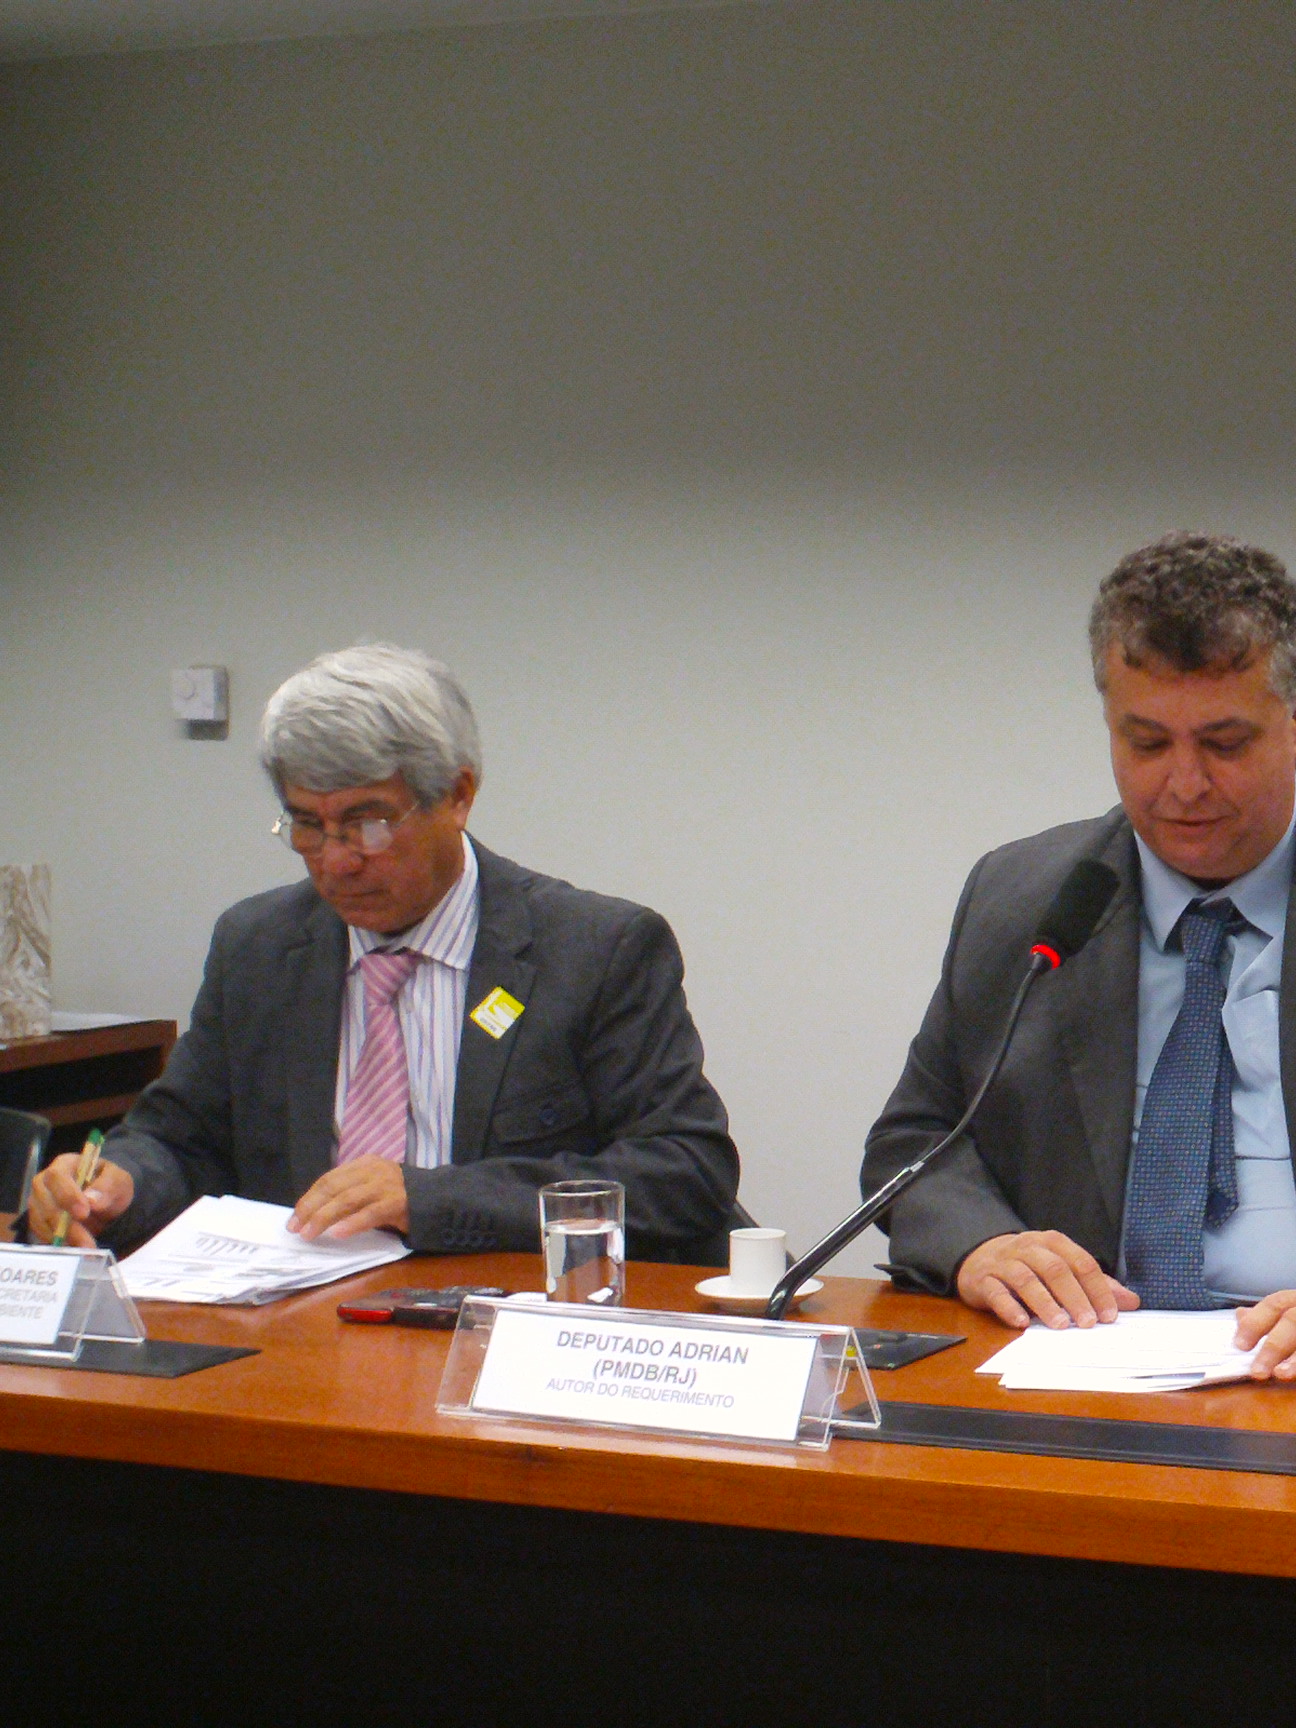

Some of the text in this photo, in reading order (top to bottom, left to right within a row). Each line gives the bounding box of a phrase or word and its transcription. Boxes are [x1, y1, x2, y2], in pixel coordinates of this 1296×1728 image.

[557, 1330, 750, 1365] DEPUTADO ADRIAN
[593, 1358, 698, 1390] (PMDB/RJ)
[544, 1378, 735, 1409] AUTOR DO REQUERIMENTO
